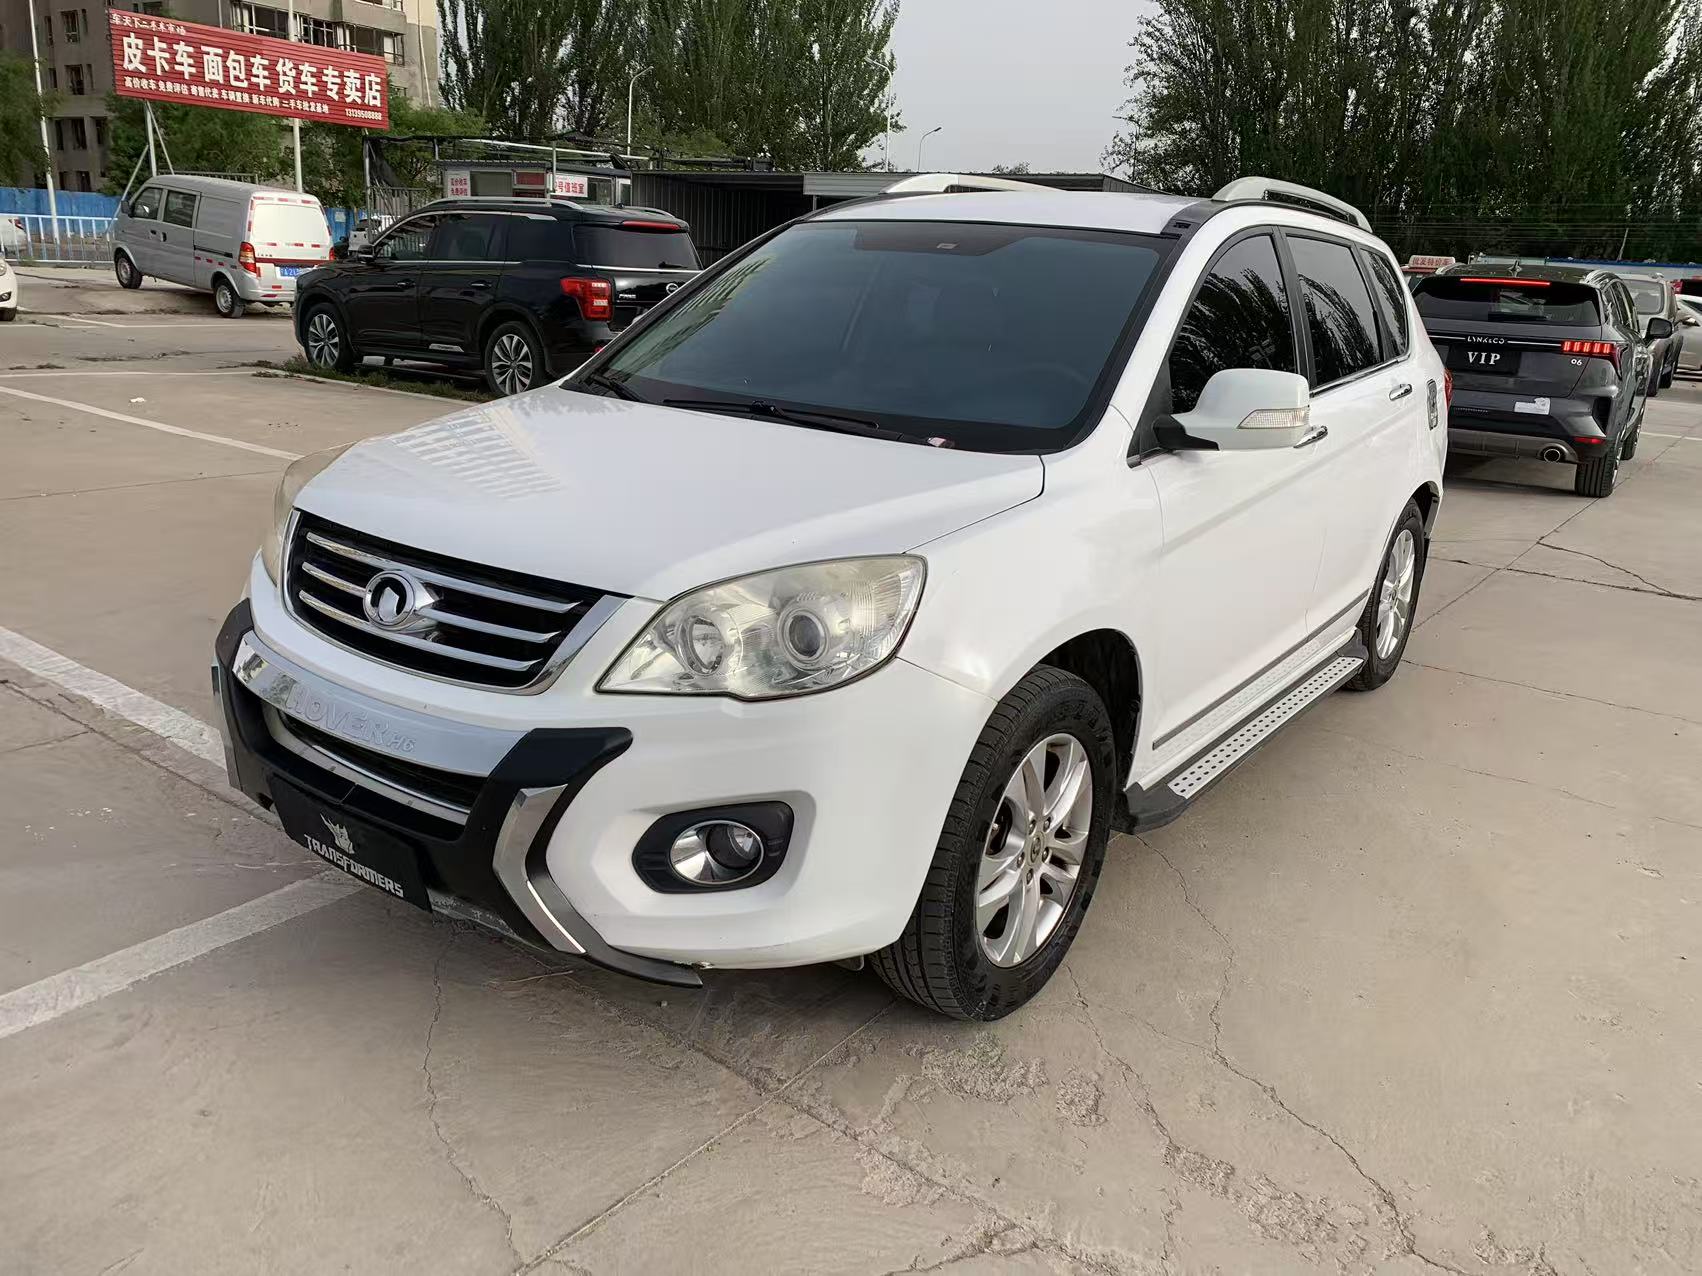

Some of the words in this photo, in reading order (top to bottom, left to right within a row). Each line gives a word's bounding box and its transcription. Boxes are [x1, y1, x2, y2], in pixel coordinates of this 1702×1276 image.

[124, 76, 157, 91] 高价收车
[158, 80, 189, 95] 免费评估
[282, 99, 329, 113] 二手车批发基地
[1467, 351, 1501, 365] VIP
[1570, 358, 1583, 366] 06
[284, 683, 390, 746] HOVER
[303, 833, 404, 898] TRANSFORMERS
